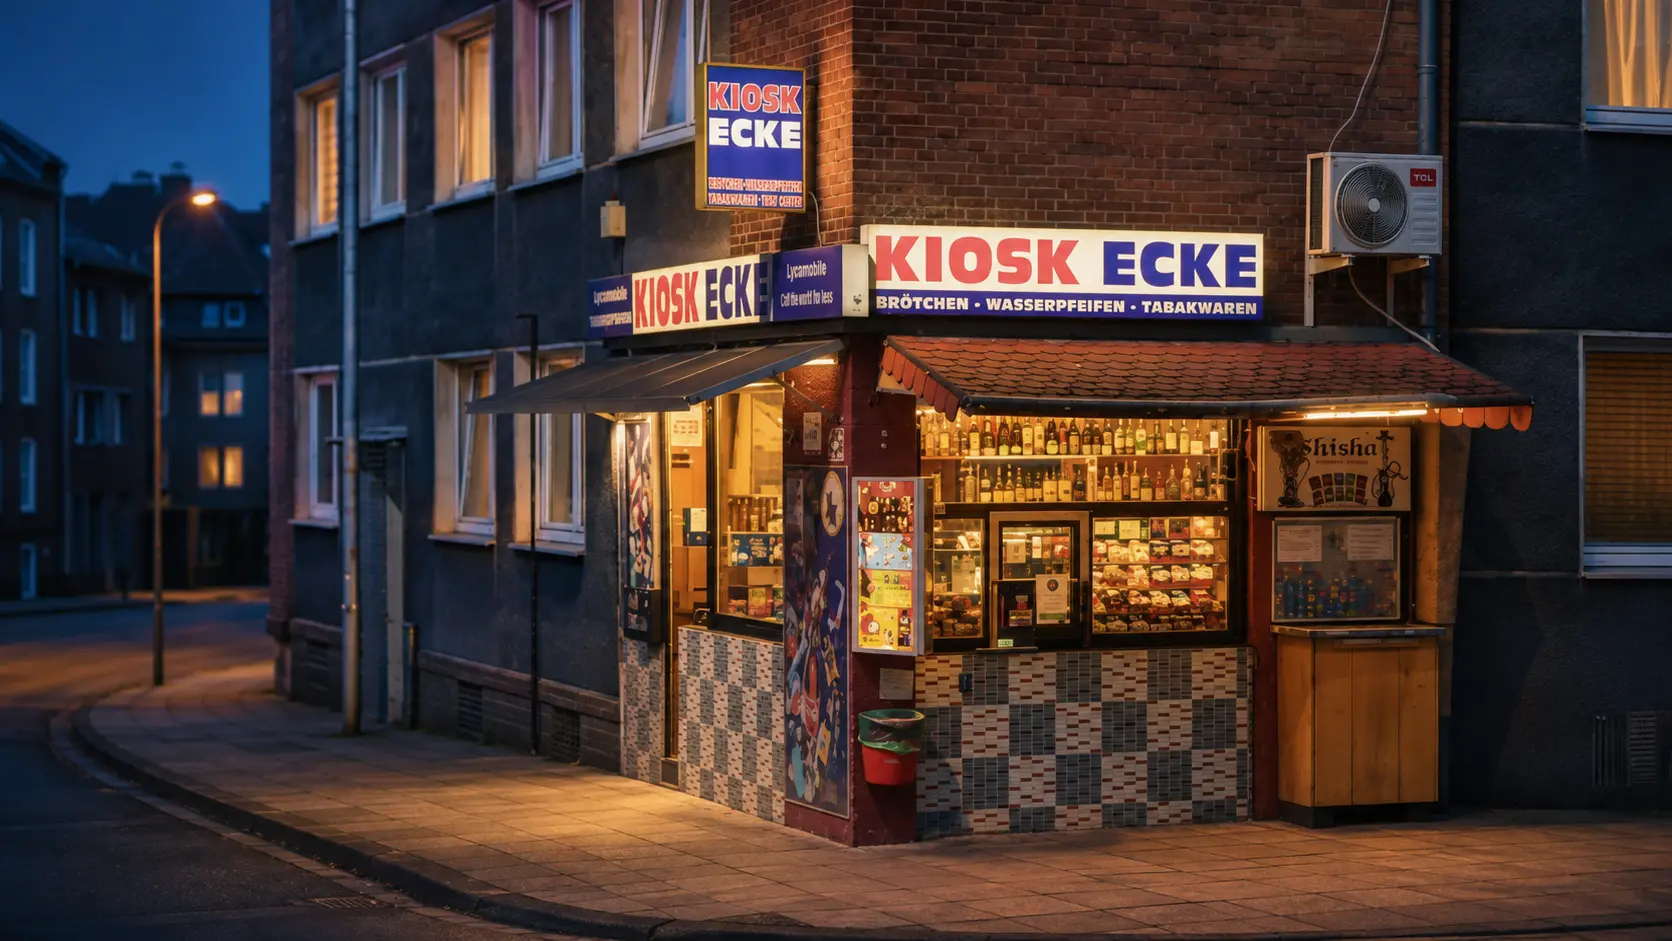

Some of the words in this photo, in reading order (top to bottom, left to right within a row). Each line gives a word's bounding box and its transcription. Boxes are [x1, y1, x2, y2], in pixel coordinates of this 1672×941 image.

[708, 81, 802, 114] KIOSK
[708, 117, 801, 149] ECKE
[1413, 173, 1434, 182] TCL
[786, 260, 827, 283] Lycamobile
[875, 235, 1080, 285] KIOSK
[1103, 241, 1257, 288] ECKE
[635, 271, 700, 329] KIOSK
[705, 262, 768, 321] ECKE
[875, 293, 969, 310] BRÖTCHEN
[986, 297, 1125, 313] WASSERPFEIFEN
[1142, 300, 1257, 315] TABAKWAREN
[1303, 436, 1378, 457] Shisha
